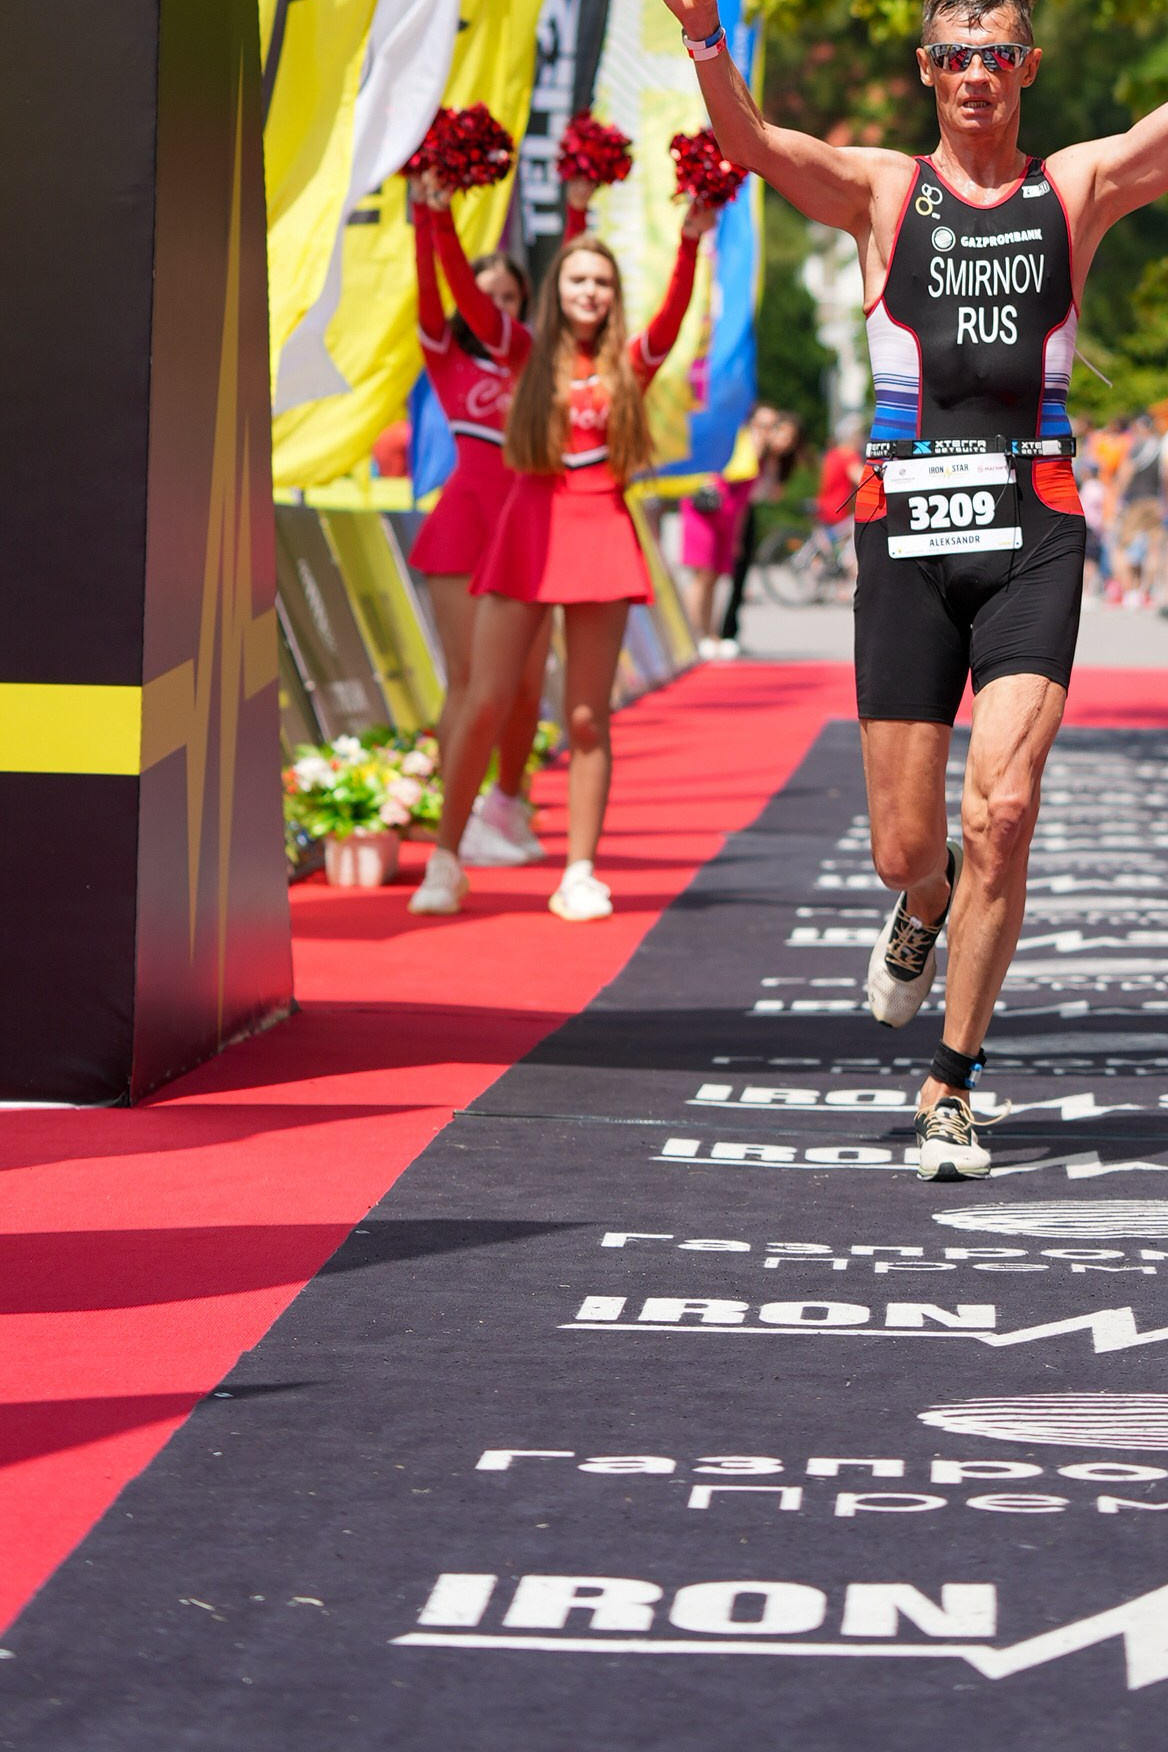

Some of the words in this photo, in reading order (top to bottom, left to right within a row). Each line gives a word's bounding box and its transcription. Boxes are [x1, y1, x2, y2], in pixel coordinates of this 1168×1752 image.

[960, 228, 1043, 249] GAZPROMBANK
[927, 253, 1045, 299] SMIRNOV
[956, 304, 1018, 346] RUS
[908, 490, 996, 531] 3209
[929, 535, 981, 547] ALEKSANDR
[661, 1137, 920, 1165] IRO
[574, 1295, 997, 1329] IRON
[415, 1573, 997, 1637] IRON
